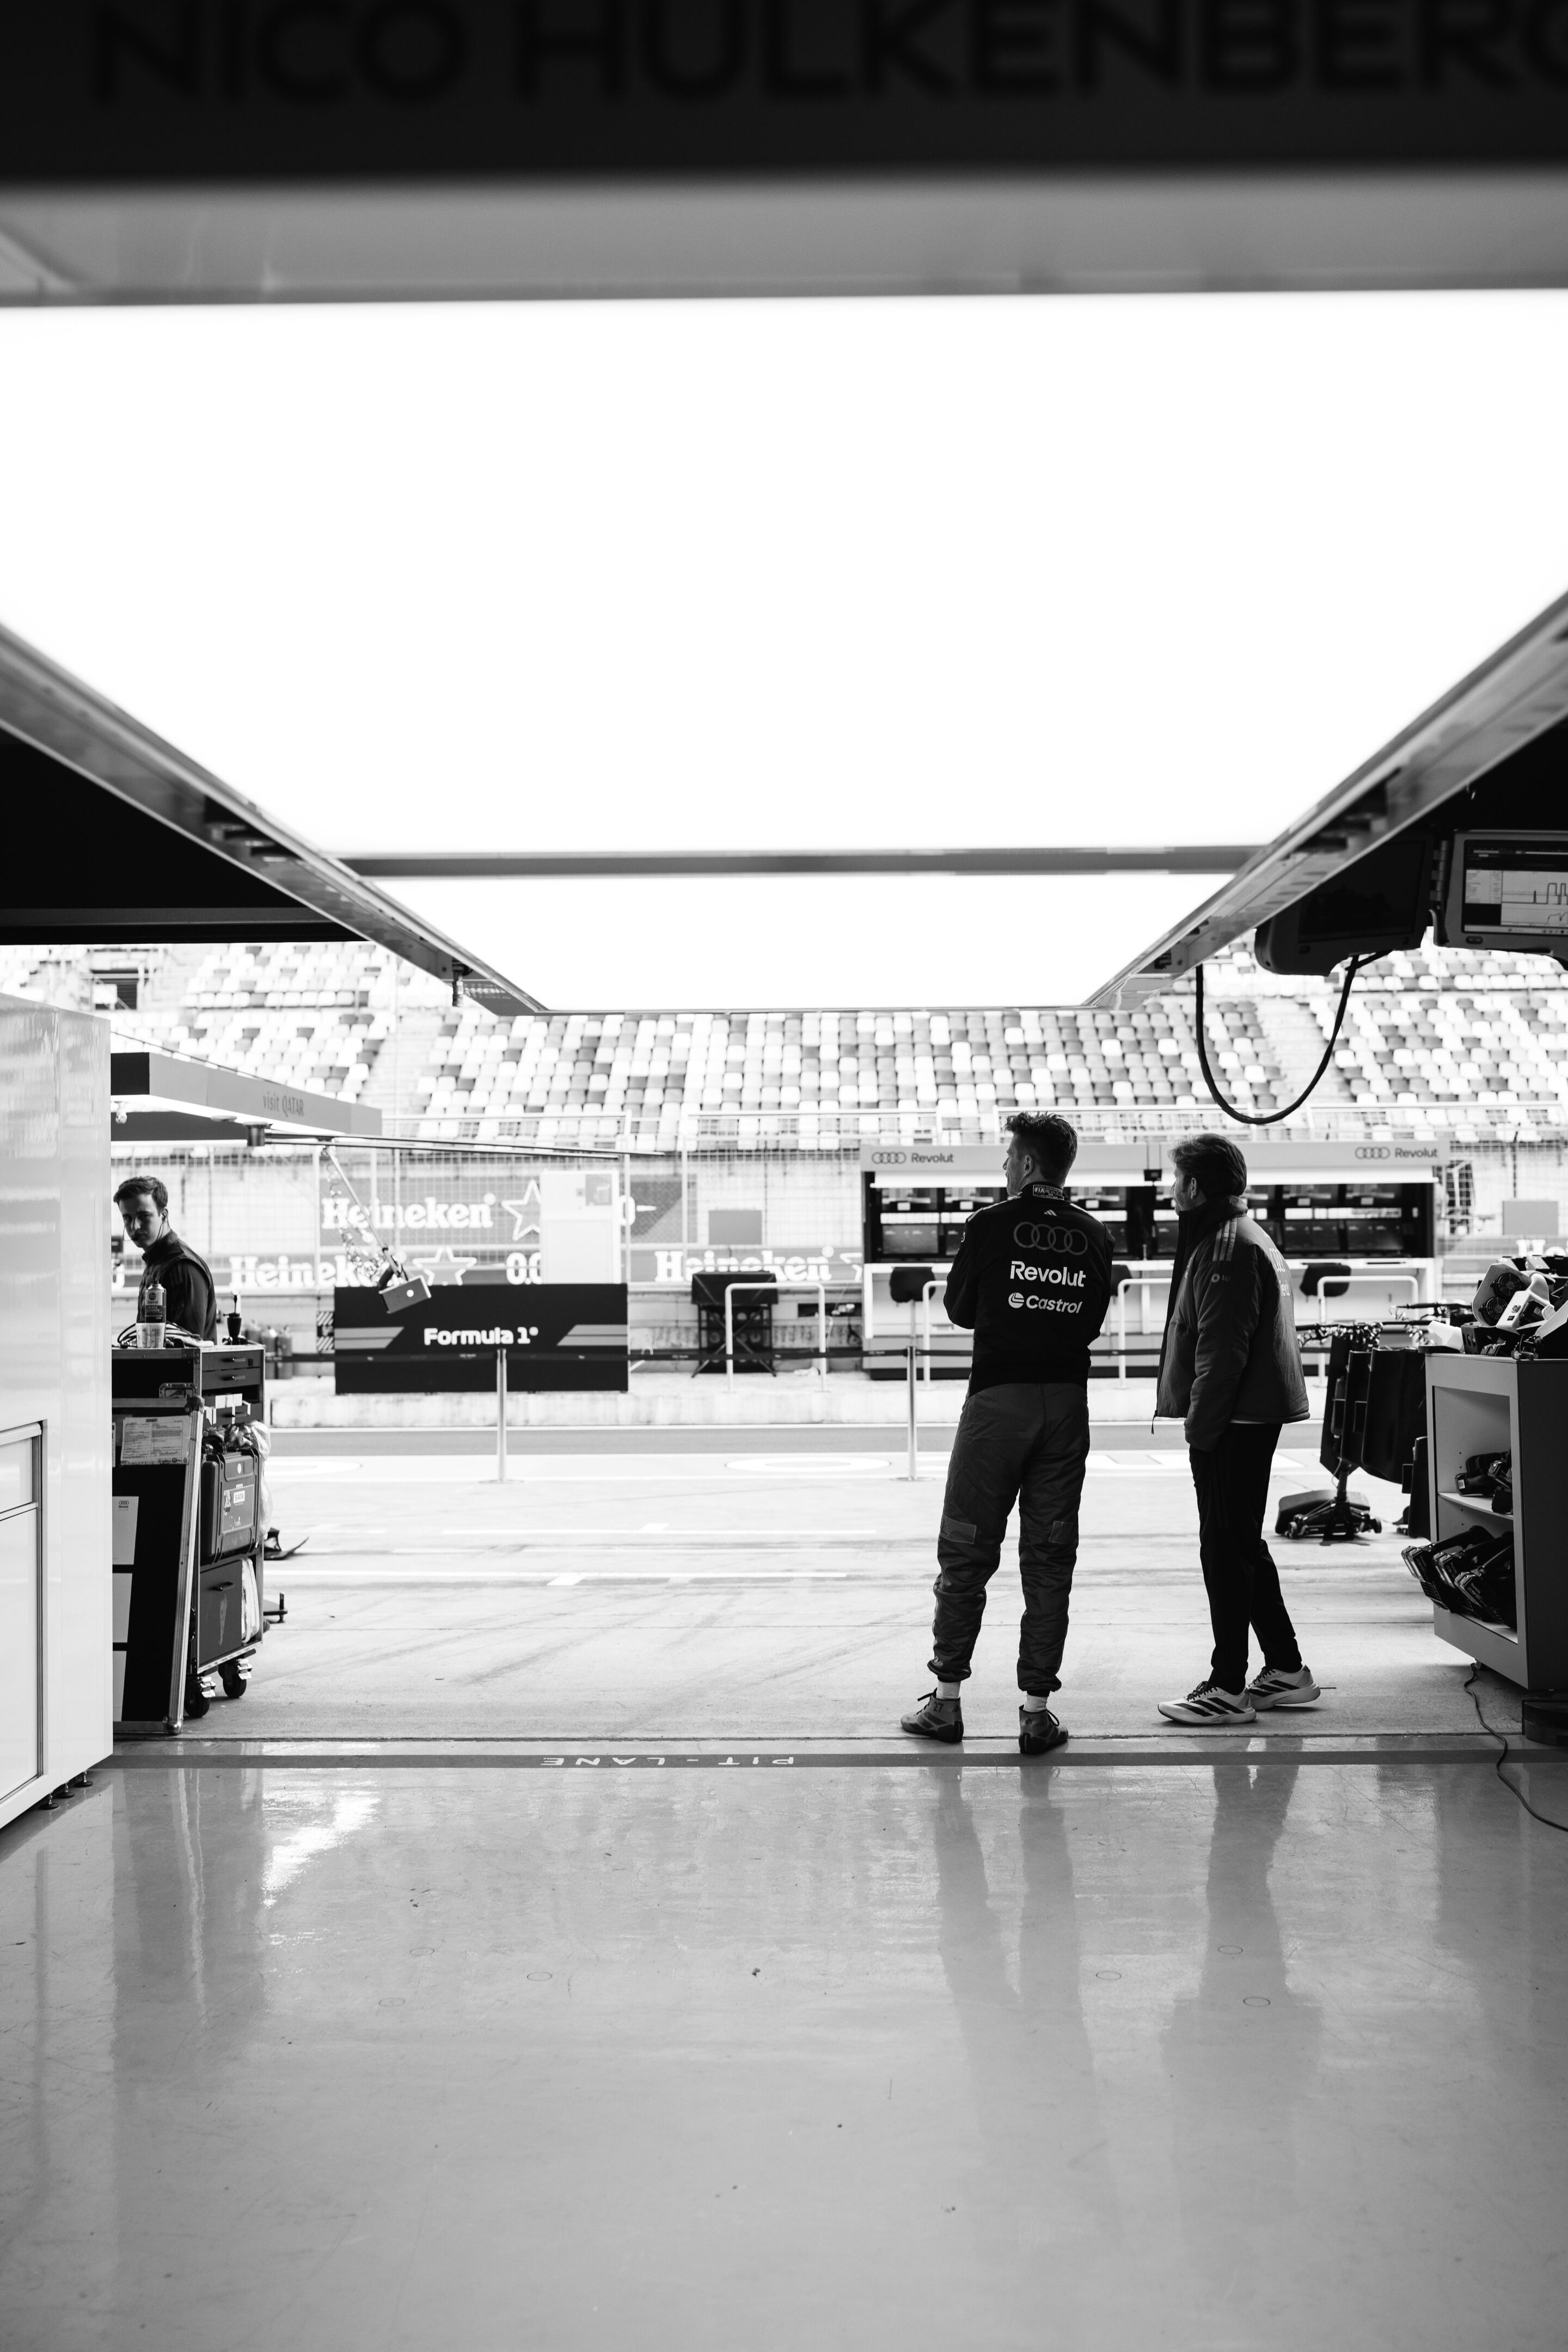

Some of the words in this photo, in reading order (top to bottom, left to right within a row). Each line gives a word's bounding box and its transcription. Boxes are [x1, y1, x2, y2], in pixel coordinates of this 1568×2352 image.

[89, 0, 469, 103] NICO
[262, 1091, 279, 1112] visit
[282, 1095, 304, 1118] QATAR
[911, 1152, 953, 1163] Revolut
[1395, 1147, 1437, 1159] Revolut
[321, 1197, 494, 1229] Heineken
[1010, 1260, 1086, 1288] Revolut
[1222, 1275, 1231, 1283] bp
[1026, 1295, 1083, 1314] Castrol
[424, 1327, 514, 1345] Formula
[933, 1701, 944, 1713] 27
